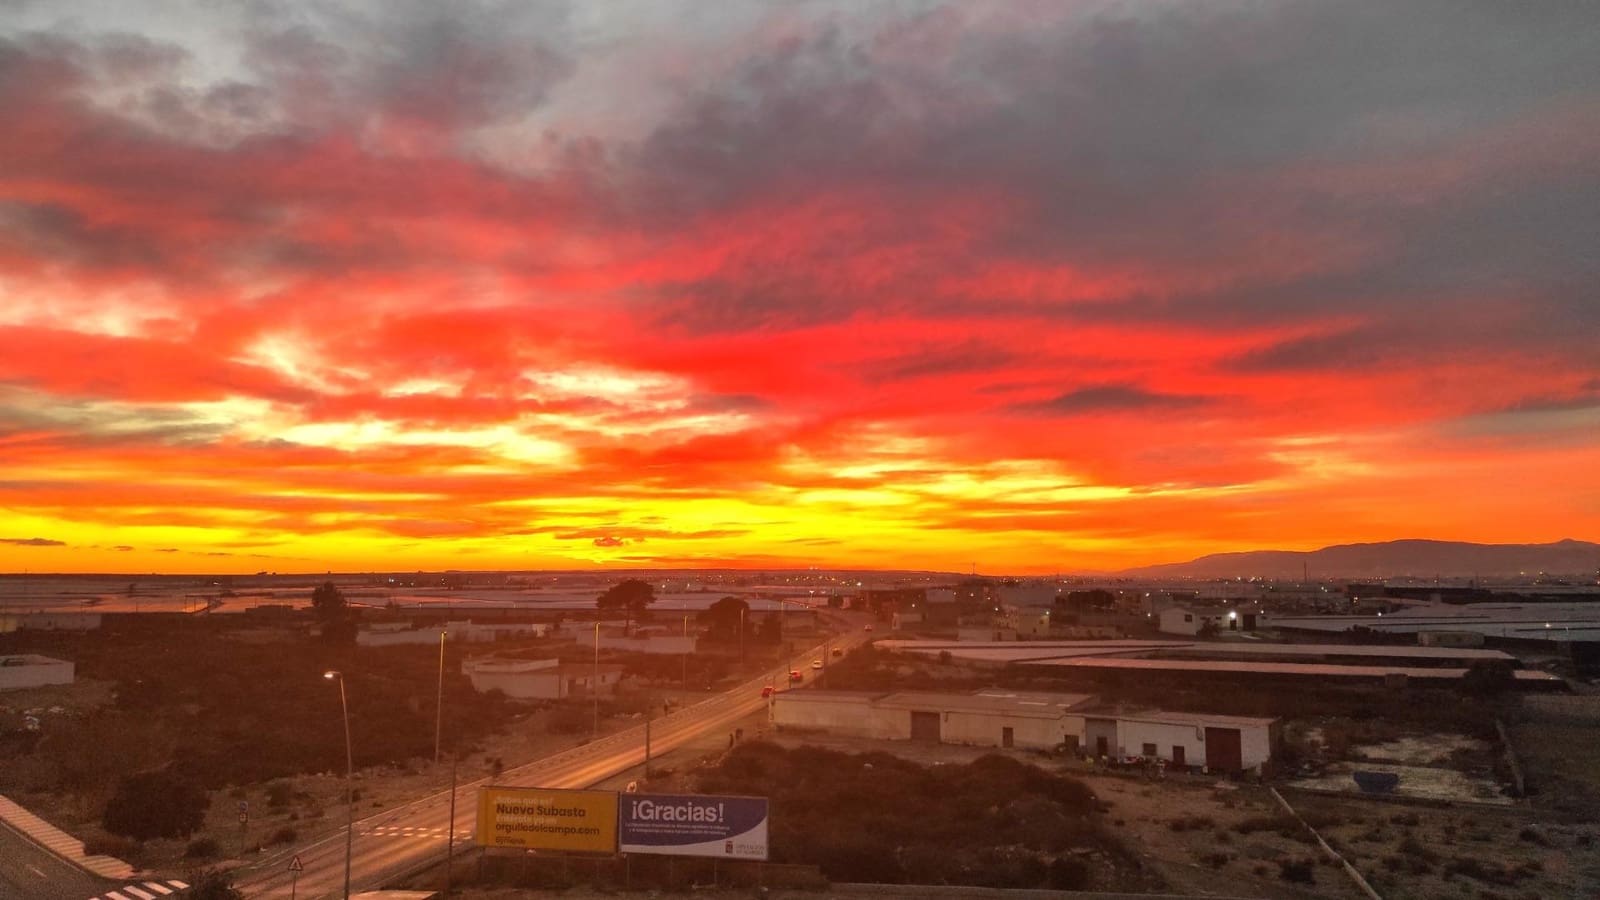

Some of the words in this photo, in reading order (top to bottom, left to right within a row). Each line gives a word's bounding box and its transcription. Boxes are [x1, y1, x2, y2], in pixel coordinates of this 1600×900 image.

[496, 804, 535, 815] Nueva
[536, 806, 586, 817] Subasta
[632, 800, 724, 822] ¡Gracias!
